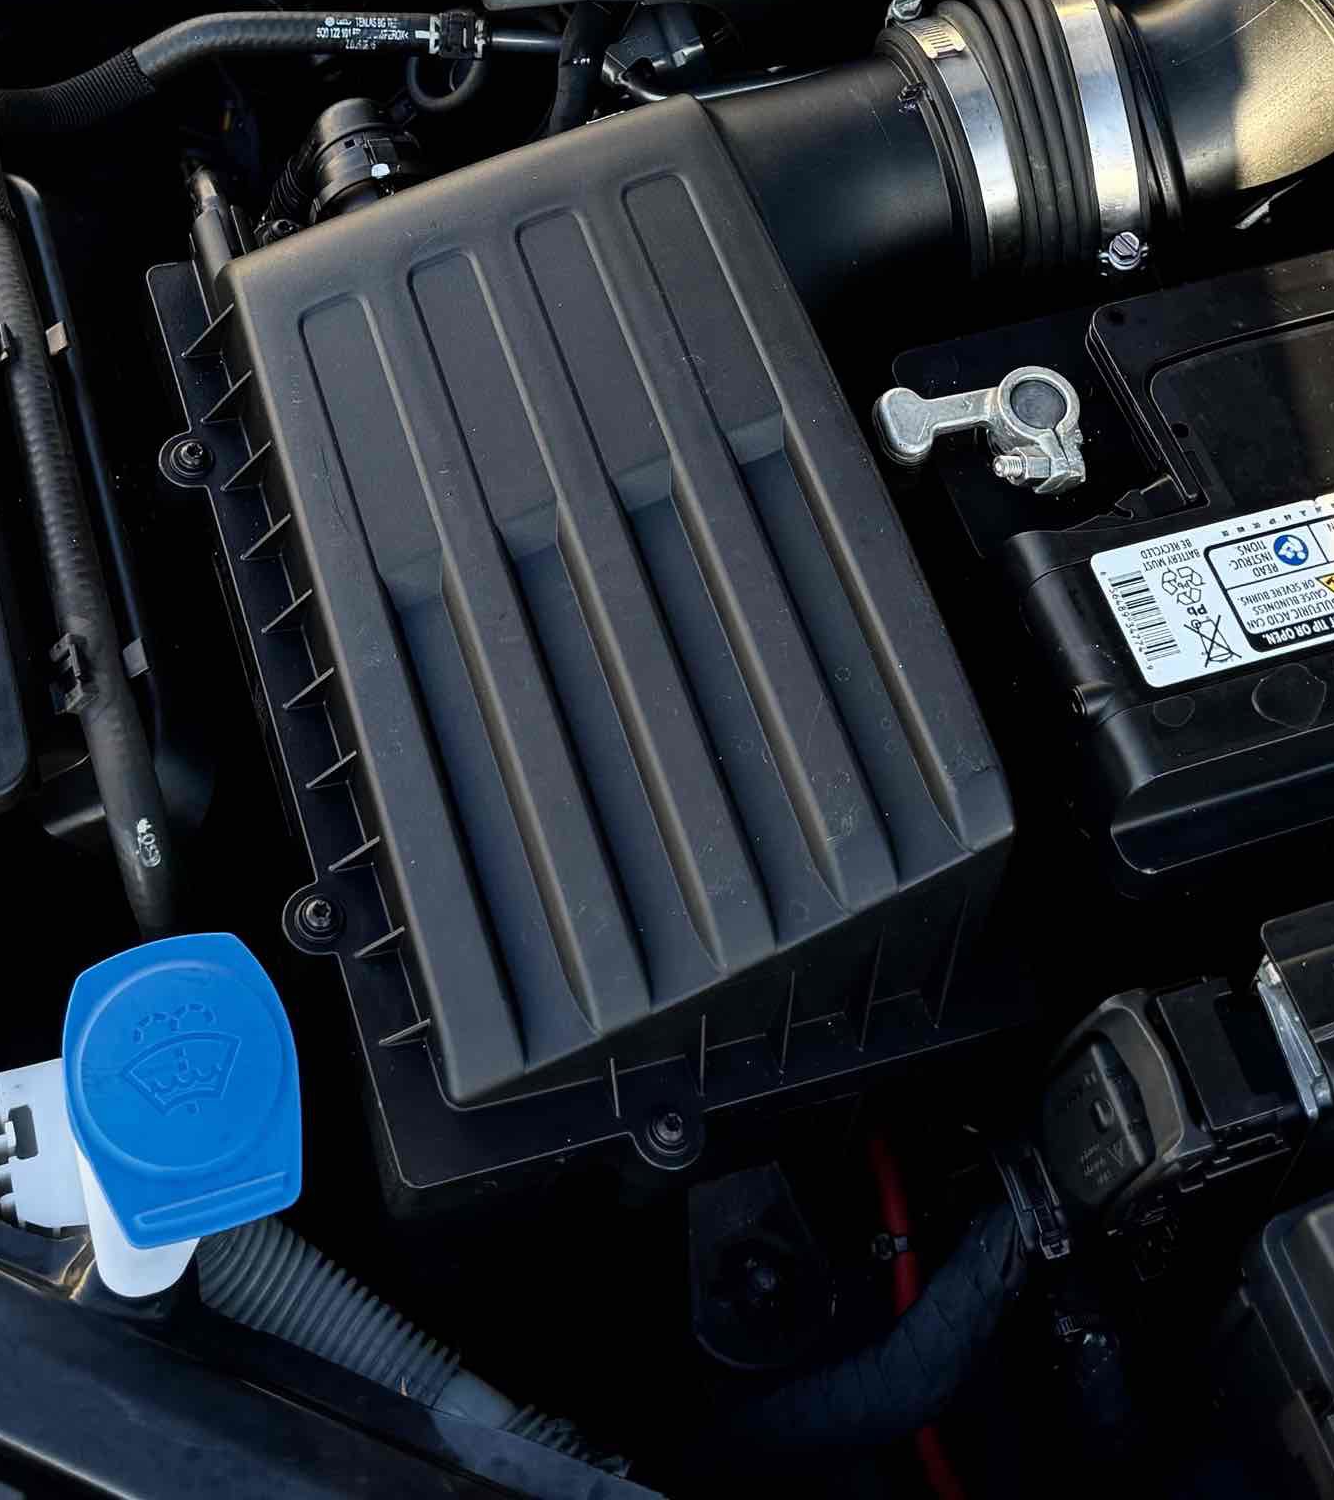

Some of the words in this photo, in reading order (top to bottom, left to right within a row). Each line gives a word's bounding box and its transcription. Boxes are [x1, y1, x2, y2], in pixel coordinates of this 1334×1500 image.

[1139, 540, 1180, 559] RECYCLED
[1179, 537, 1191, 549] BE
[1142, 556, 1165, 571] MUST
[1165, 547, 1199, 565] BATTERY
[1251, 561, 1278, 578] READ
[1270, 581, 1301, 599] SEVERE
[1301, 577, 1315, 590] OR
[1300, 587, 1327, 602] CAUSE
[1186, 603, 1206, 618] Pb
[1251, 594, 1299, 616] BLINDNESS
[1246, 616, 1266, 631] CAN
[1266, 609, 1290, 626] ACID
[1310, 617, 1328, 633] TIP
[1262, 626, 1295, 646] OPEN.
[1293, 621, 1311, 637] OR
